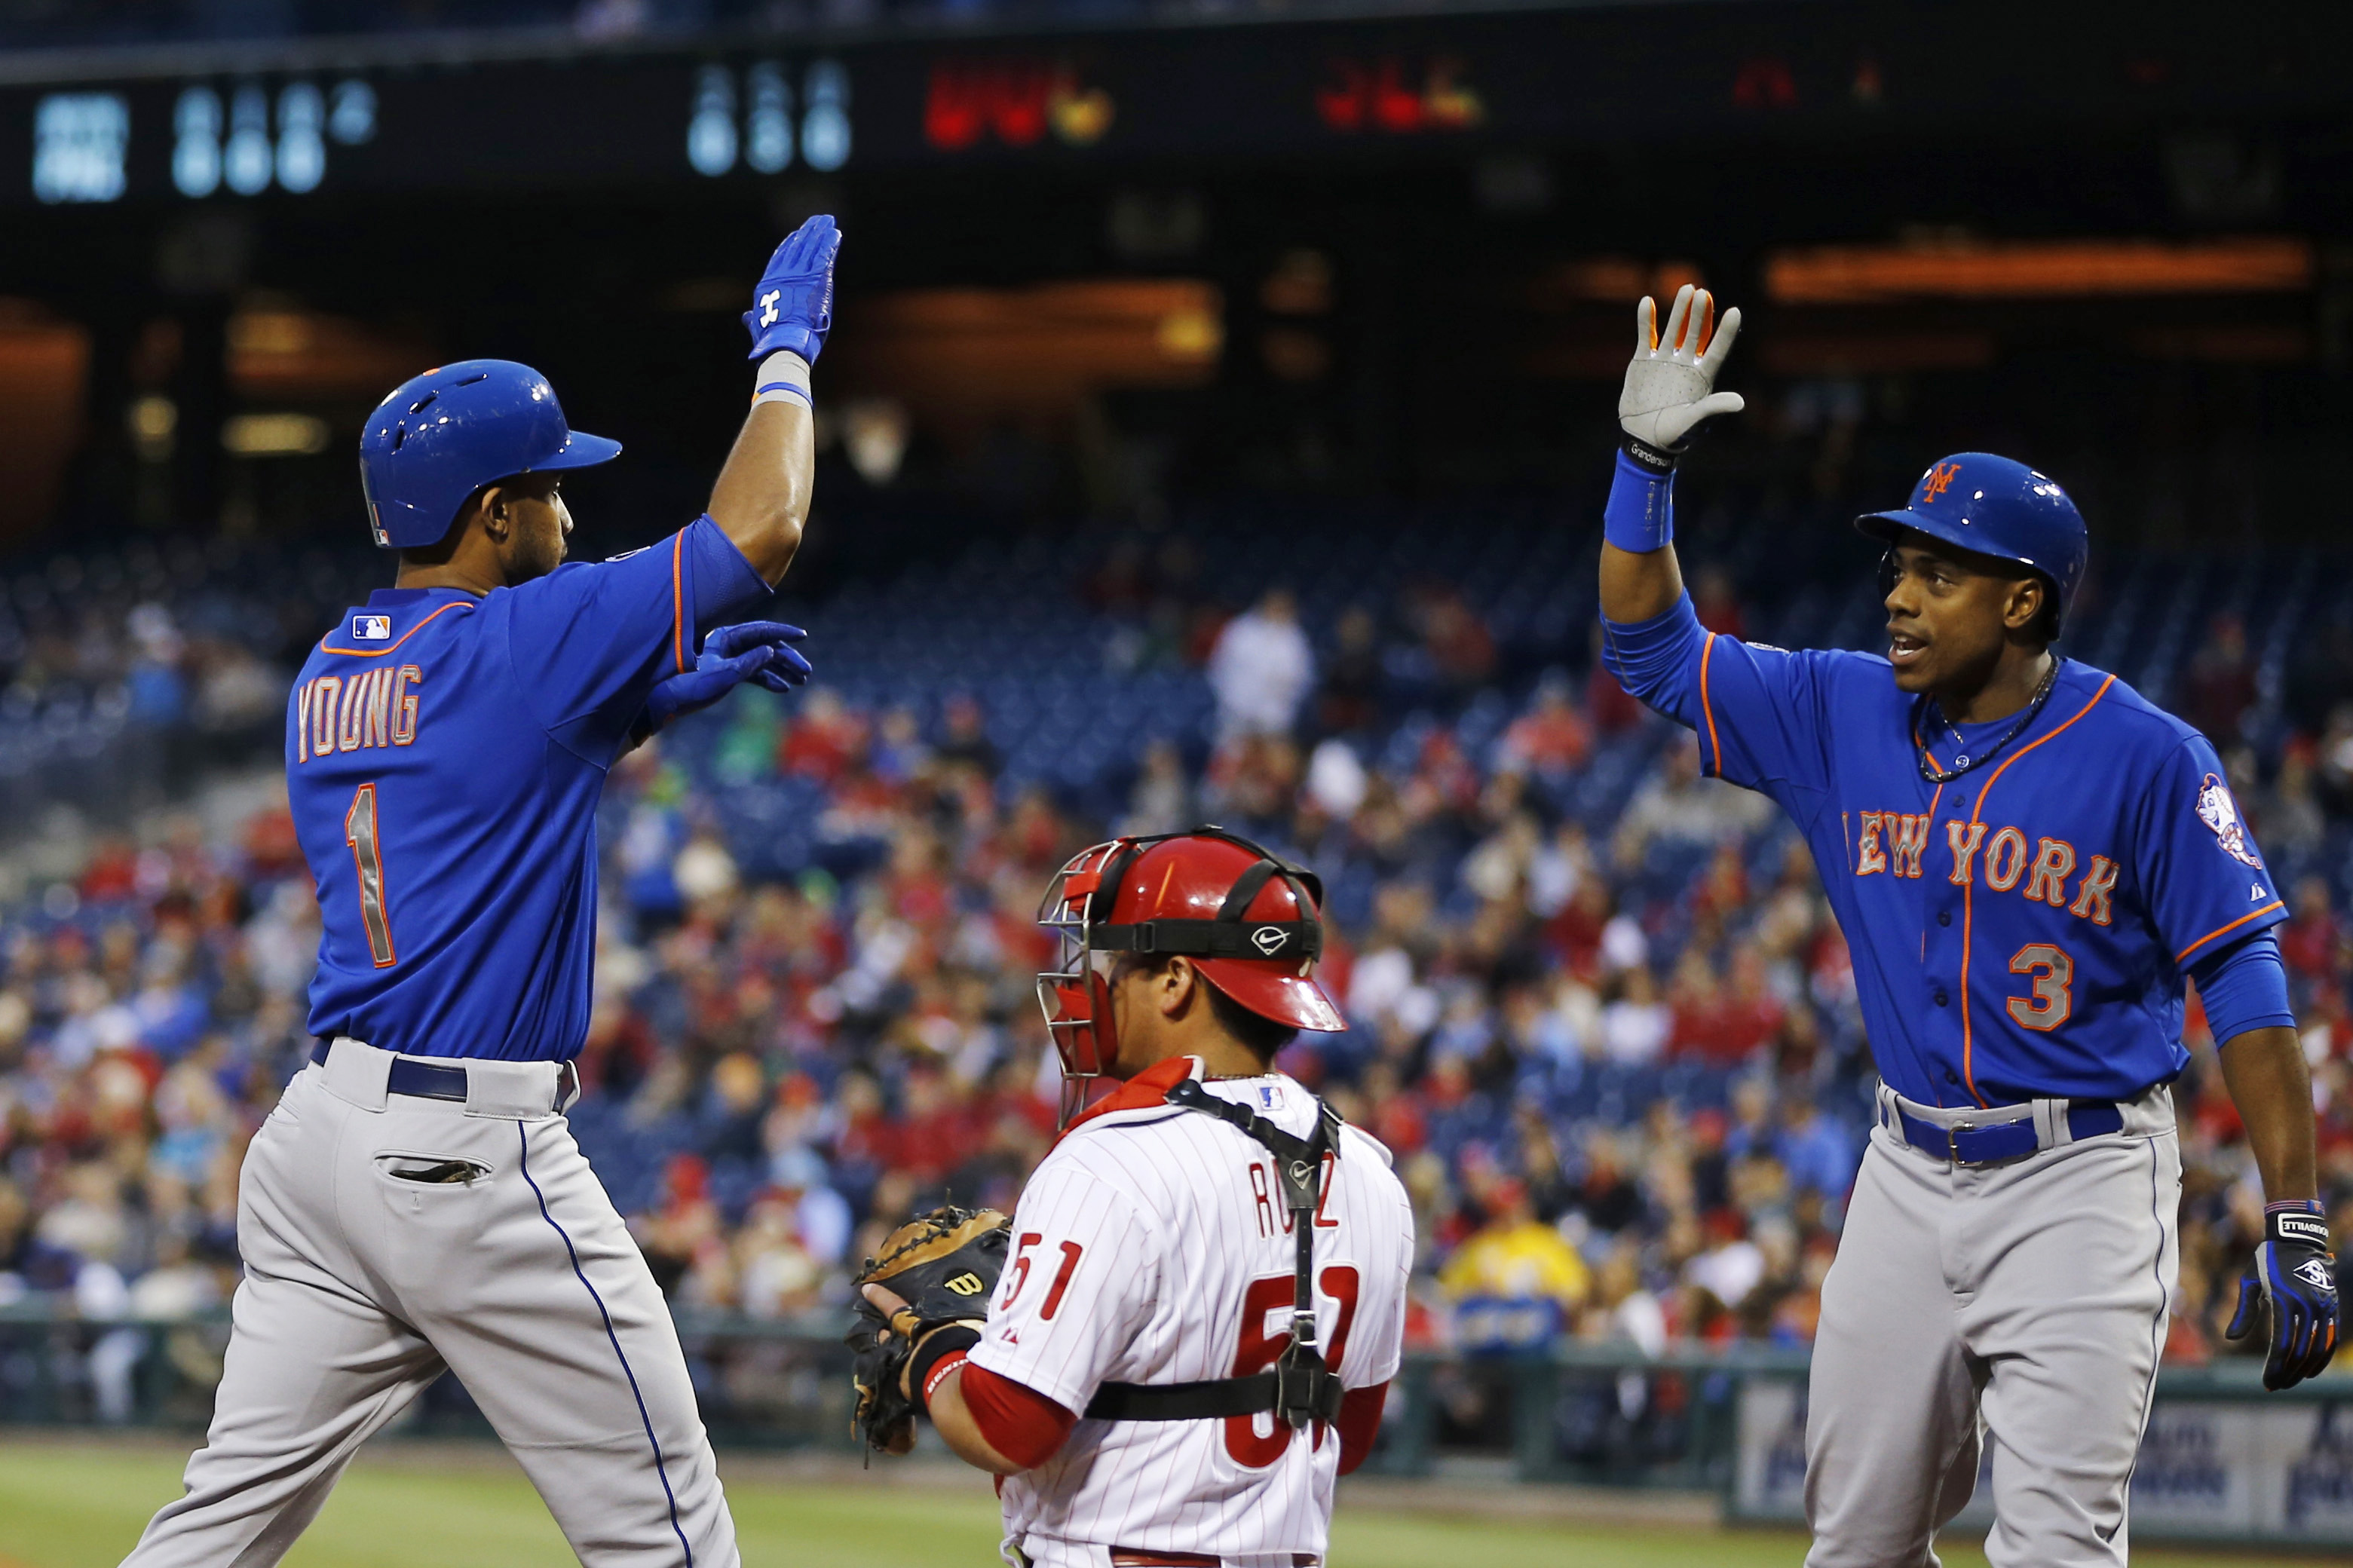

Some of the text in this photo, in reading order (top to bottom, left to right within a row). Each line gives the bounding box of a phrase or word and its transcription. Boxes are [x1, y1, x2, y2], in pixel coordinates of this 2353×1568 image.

[1631, 444, 1671, 467] Granderson
[299, 664, 422, 764] YOUNG
[345, 782, 397, 969] 1
[1841, 810, 2120, 926] EW YORK
[2006, 942, 2074, 1032] 3
[1000, 1233, 1083, 1321] 51
[1224, 1265, 1359, 1468] 51
